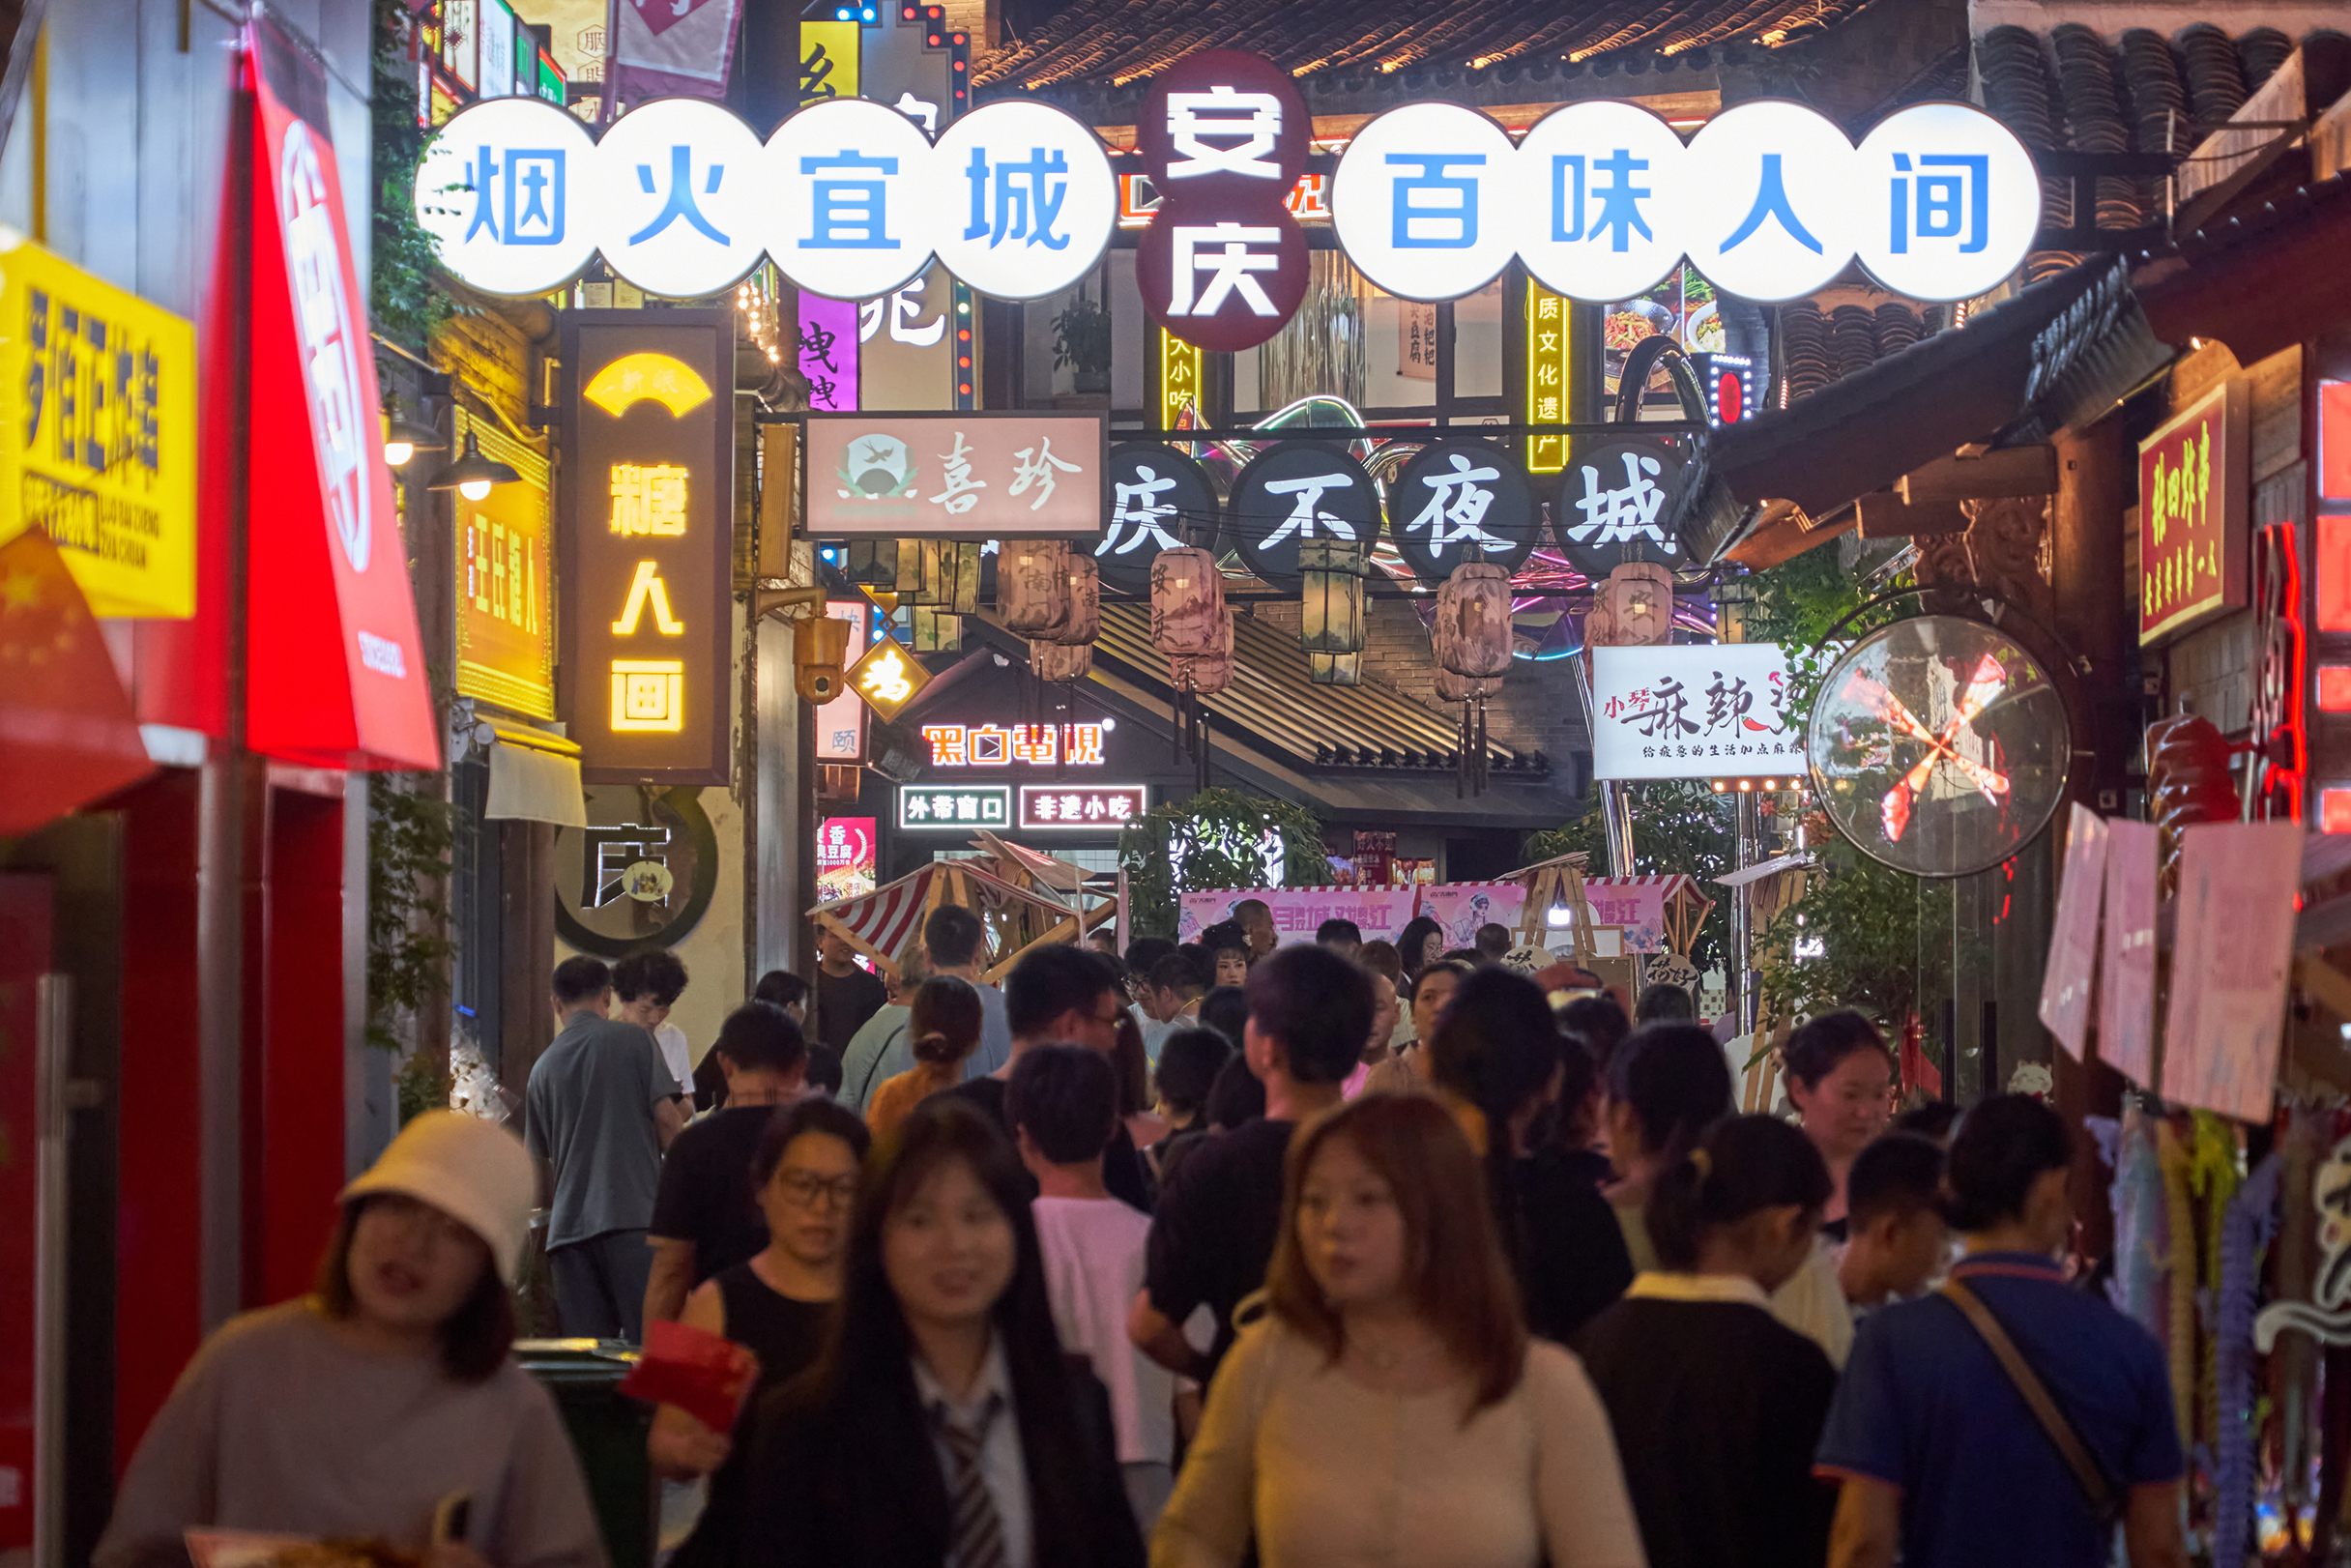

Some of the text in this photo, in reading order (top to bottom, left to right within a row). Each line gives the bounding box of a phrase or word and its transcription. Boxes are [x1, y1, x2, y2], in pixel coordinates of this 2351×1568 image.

[465, 145, 1070, 251] 烟火宜城
[1384, 148, 1989, 255] 百味人间
[1166, 85, 1283, 317] 安庆
[928, 431, 1084, 515] 喜珍
[981, 452, 1676, 559] 庆不夜城
[610, 464, 689, 732] 糖人画
[1603, 686, 1651, 719] 小琴
[907, 795, 1002, 821] 外带窗口
[1033, 795, 1132, 821] 非遗小吃
